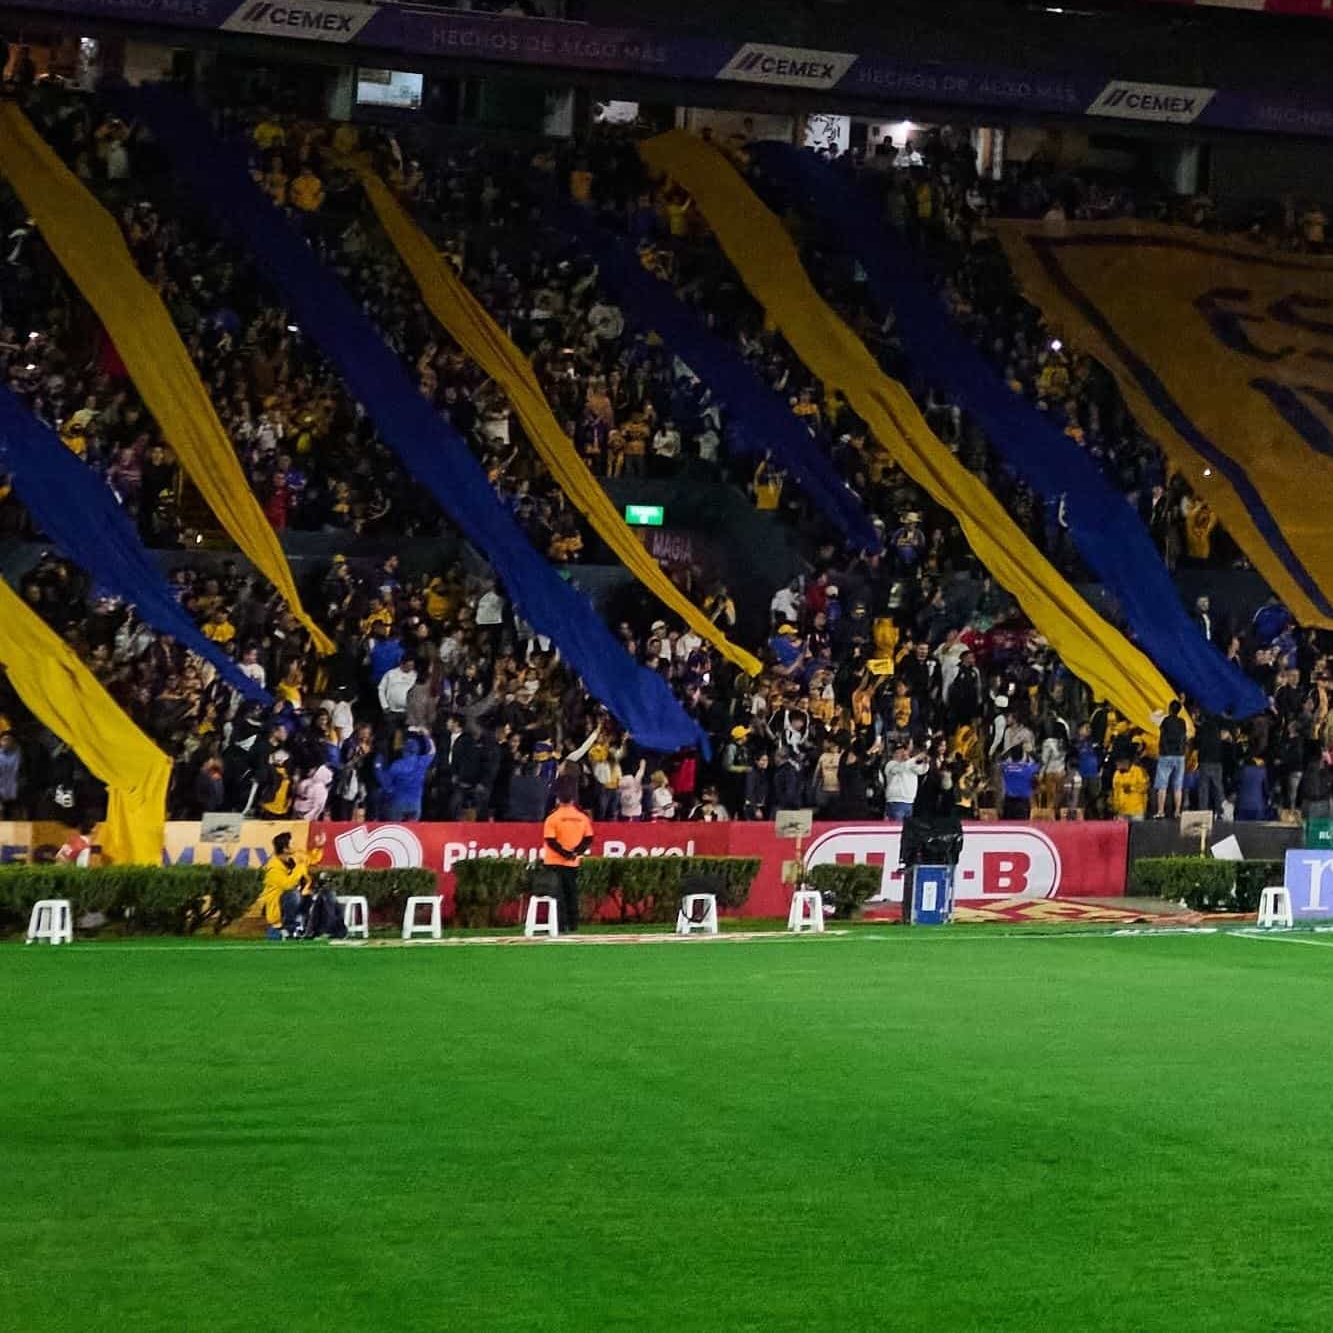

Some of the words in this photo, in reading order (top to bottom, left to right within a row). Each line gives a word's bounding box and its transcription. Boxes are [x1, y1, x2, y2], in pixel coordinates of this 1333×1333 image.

[270, 12, 352, 32] CEMEX
[762, 57, 834, 79] CEMEX
[1127, 94, 1194, 113] CEMEX
